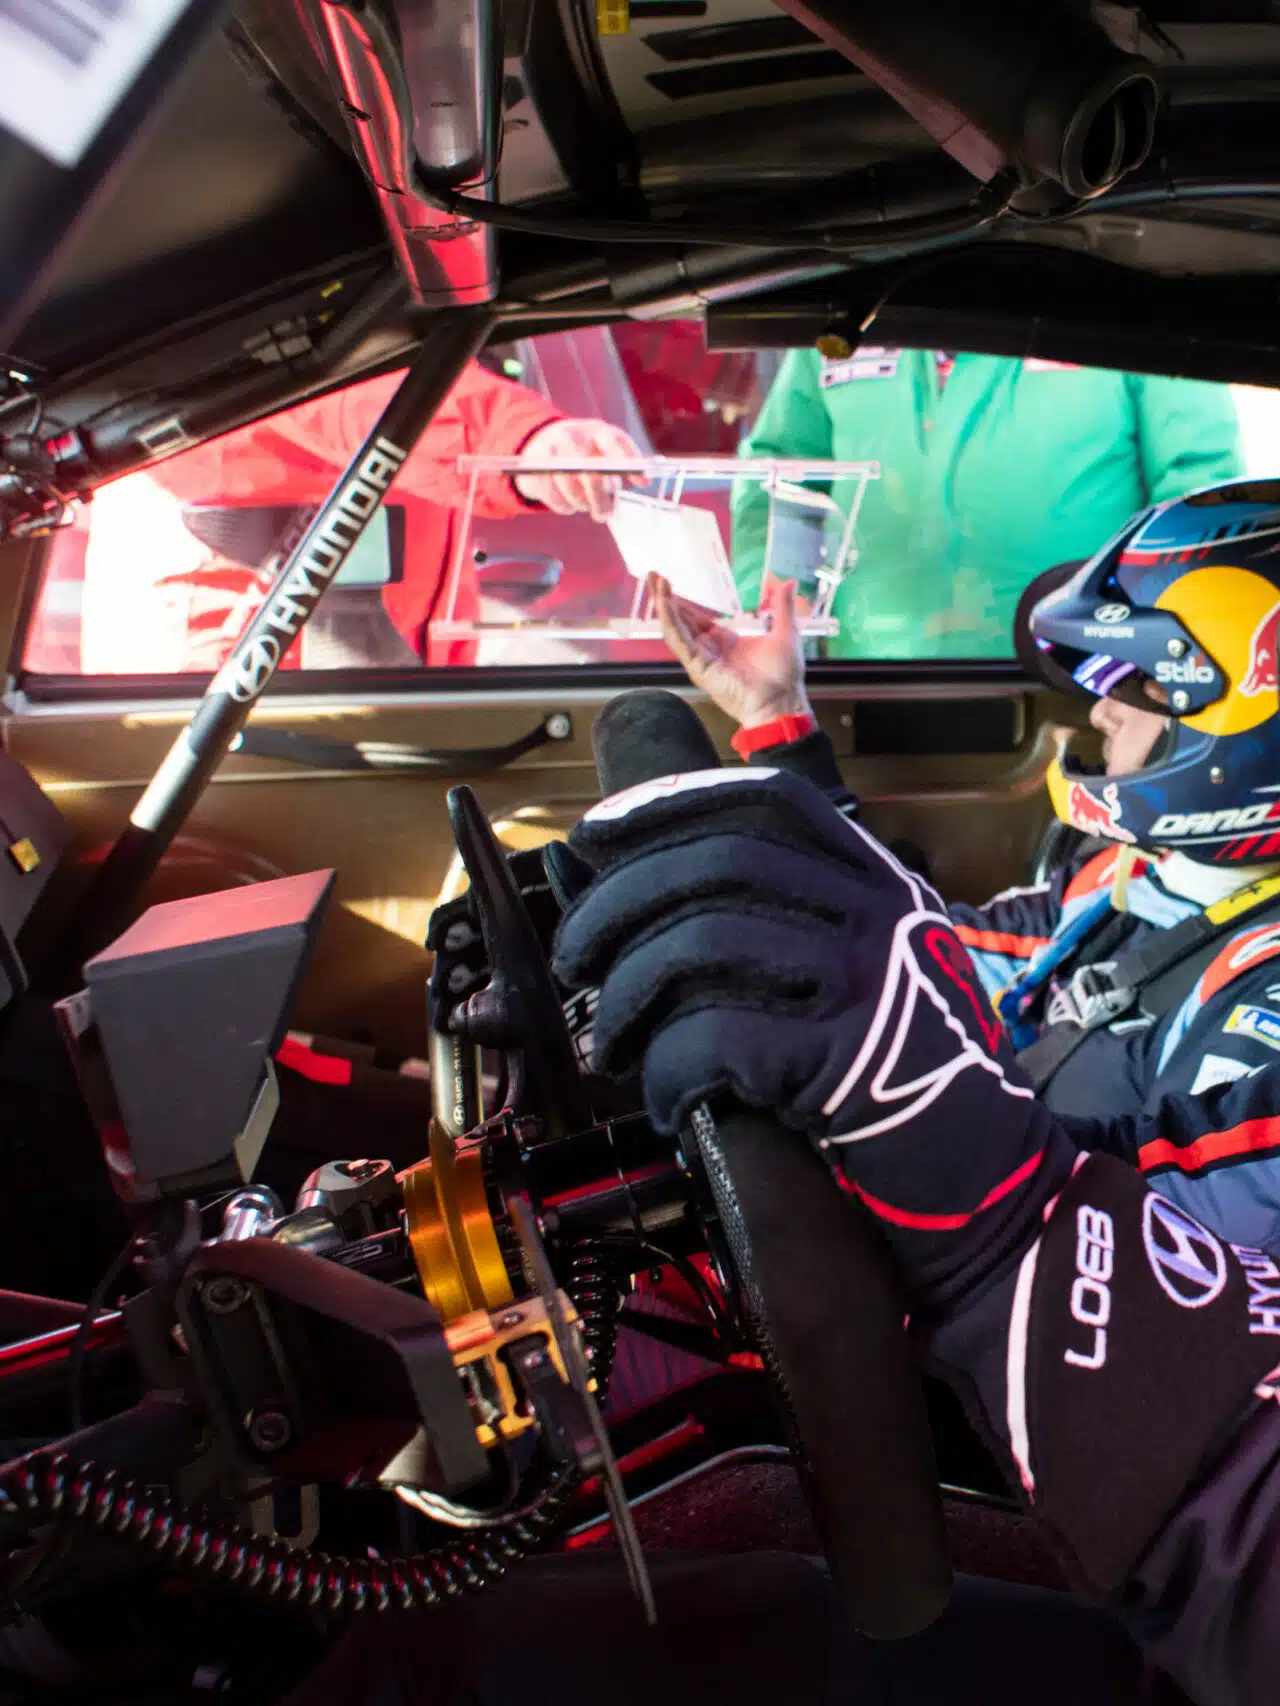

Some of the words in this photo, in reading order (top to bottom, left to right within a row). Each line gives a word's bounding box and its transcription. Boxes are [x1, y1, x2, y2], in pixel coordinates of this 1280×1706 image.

[267, 436, 409, 635] HYUNDAI
[1155, 655, 1215, 683] Stilo
[1063, 1204, 1114, 1370] LOEB
